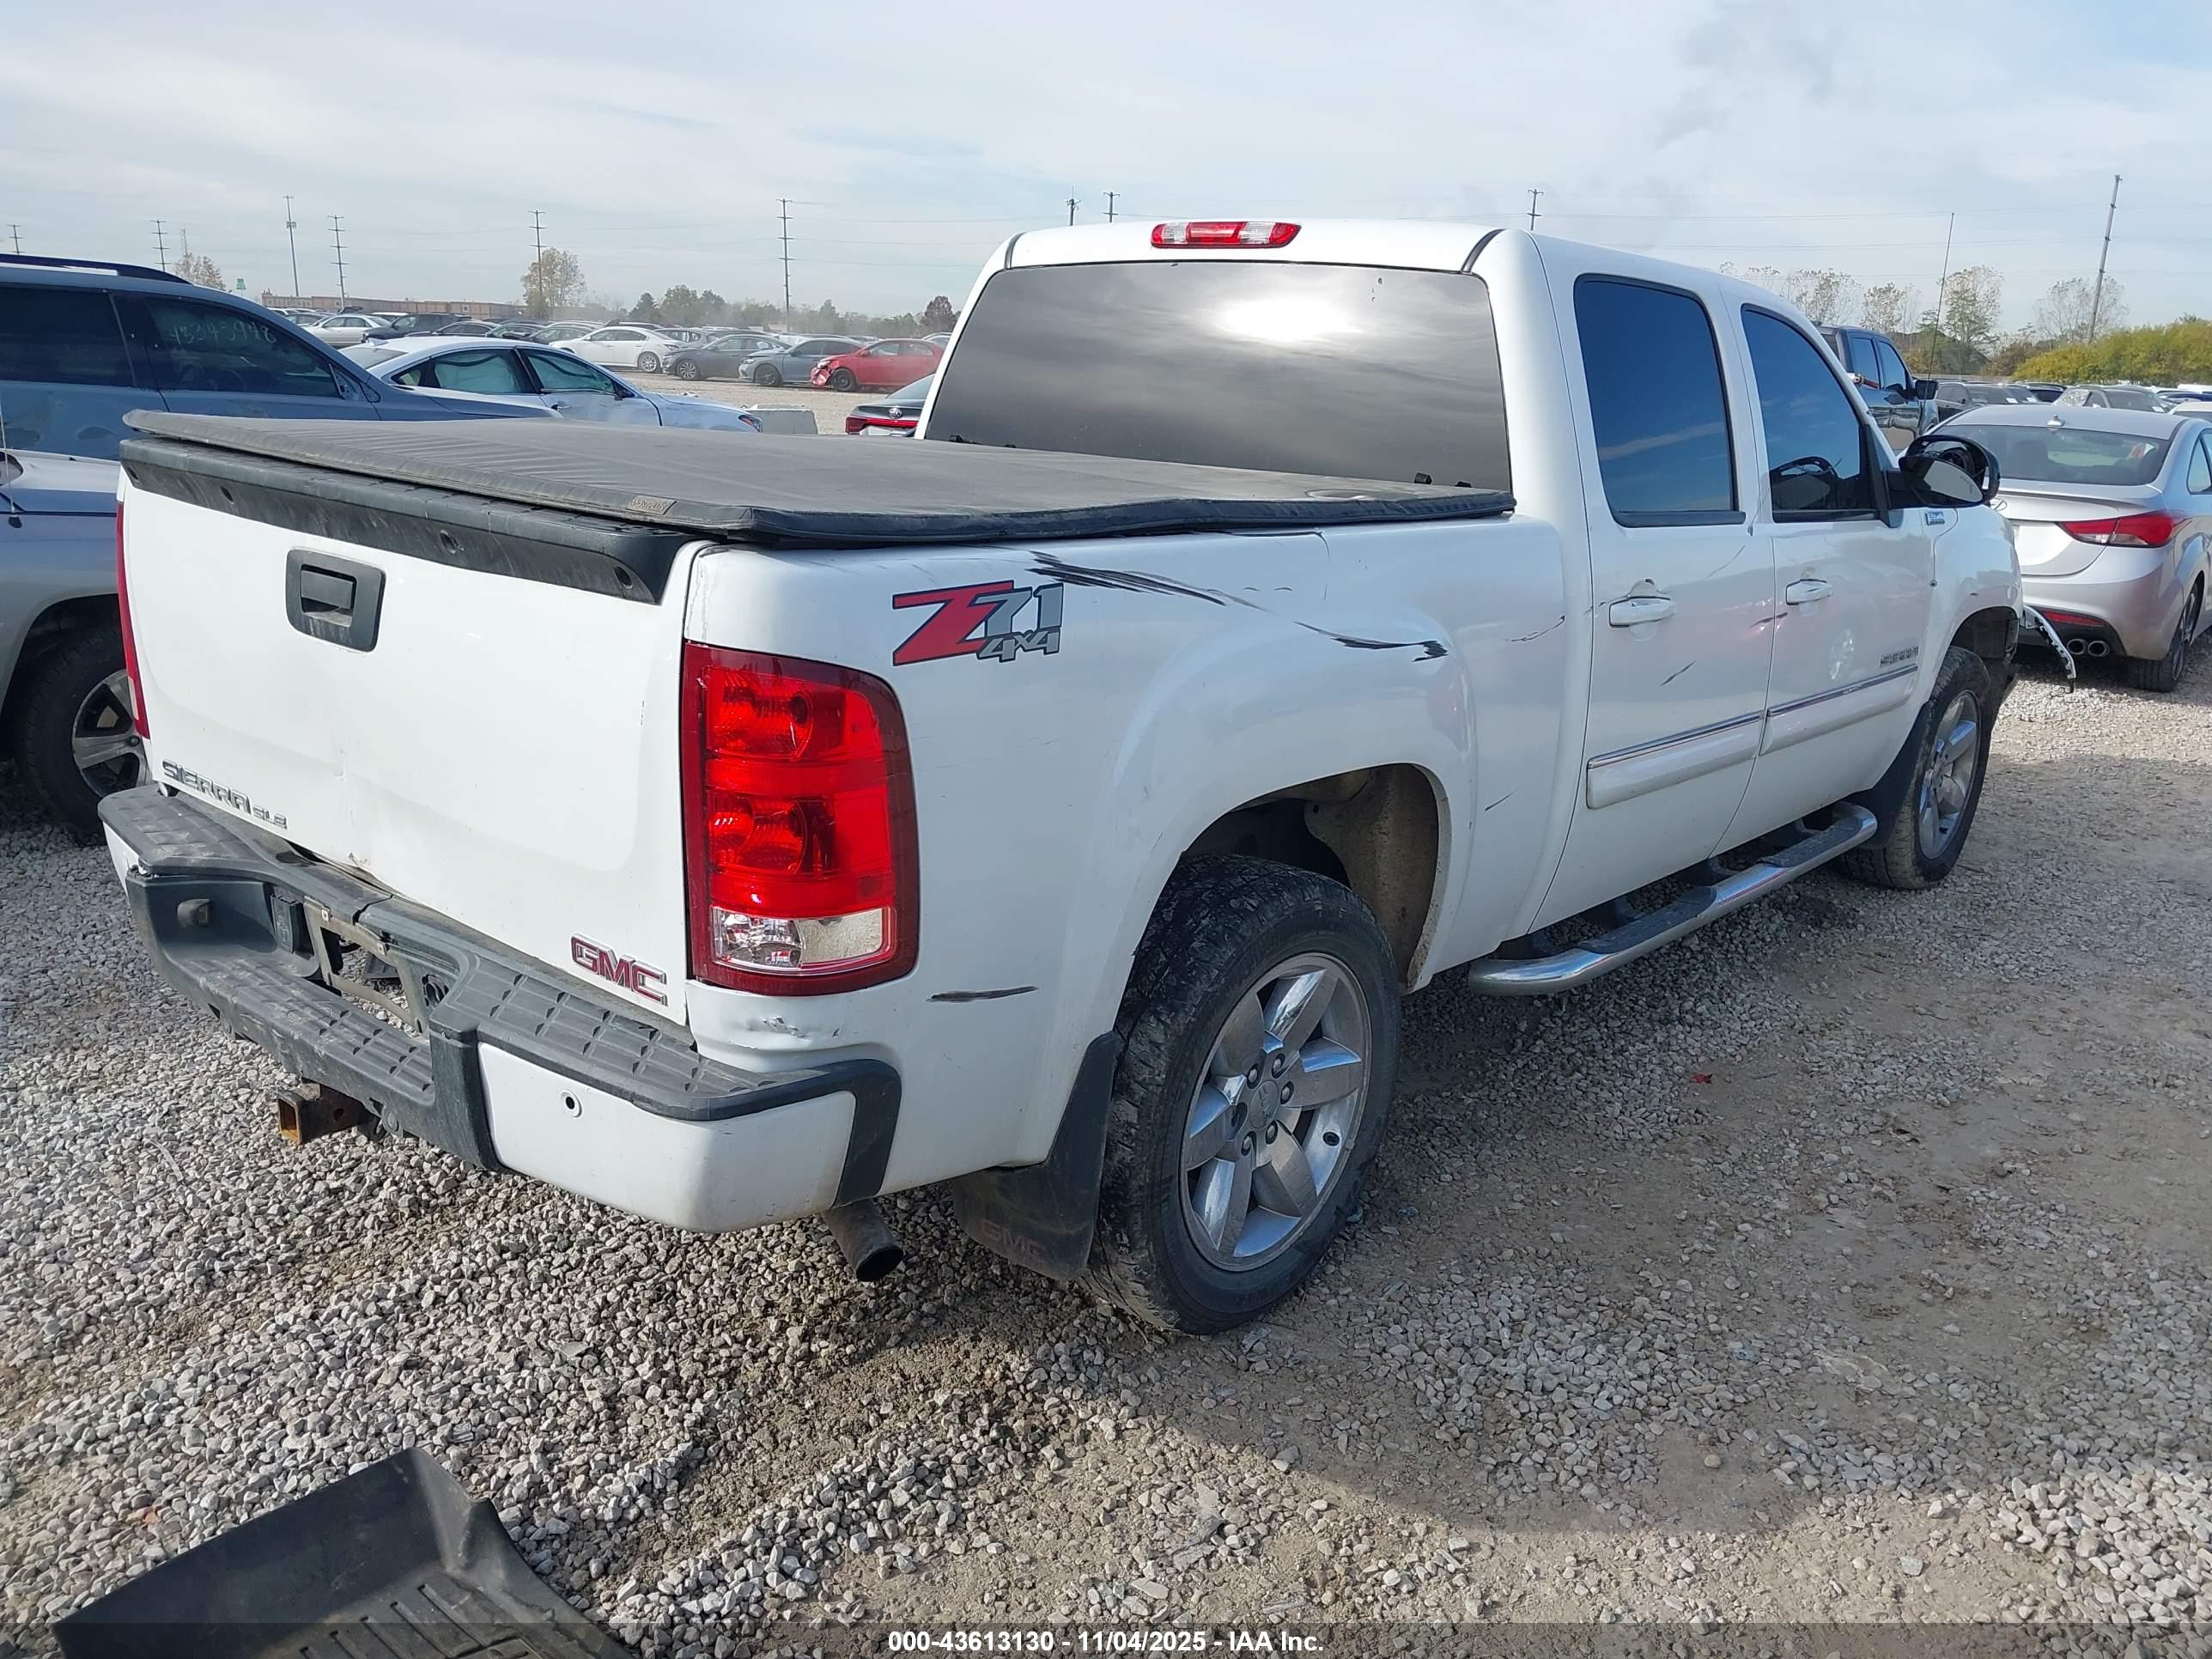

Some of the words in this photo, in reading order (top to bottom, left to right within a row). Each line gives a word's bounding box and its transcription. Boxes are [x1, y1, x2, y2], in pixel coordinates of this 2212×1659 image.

[892, 580, 1064, 666] Z71
[161, 758, 252, 816] SIERRA
[571, 933, 669, 1007] GMC
[982, 1218, 1044, 1261] GMC
